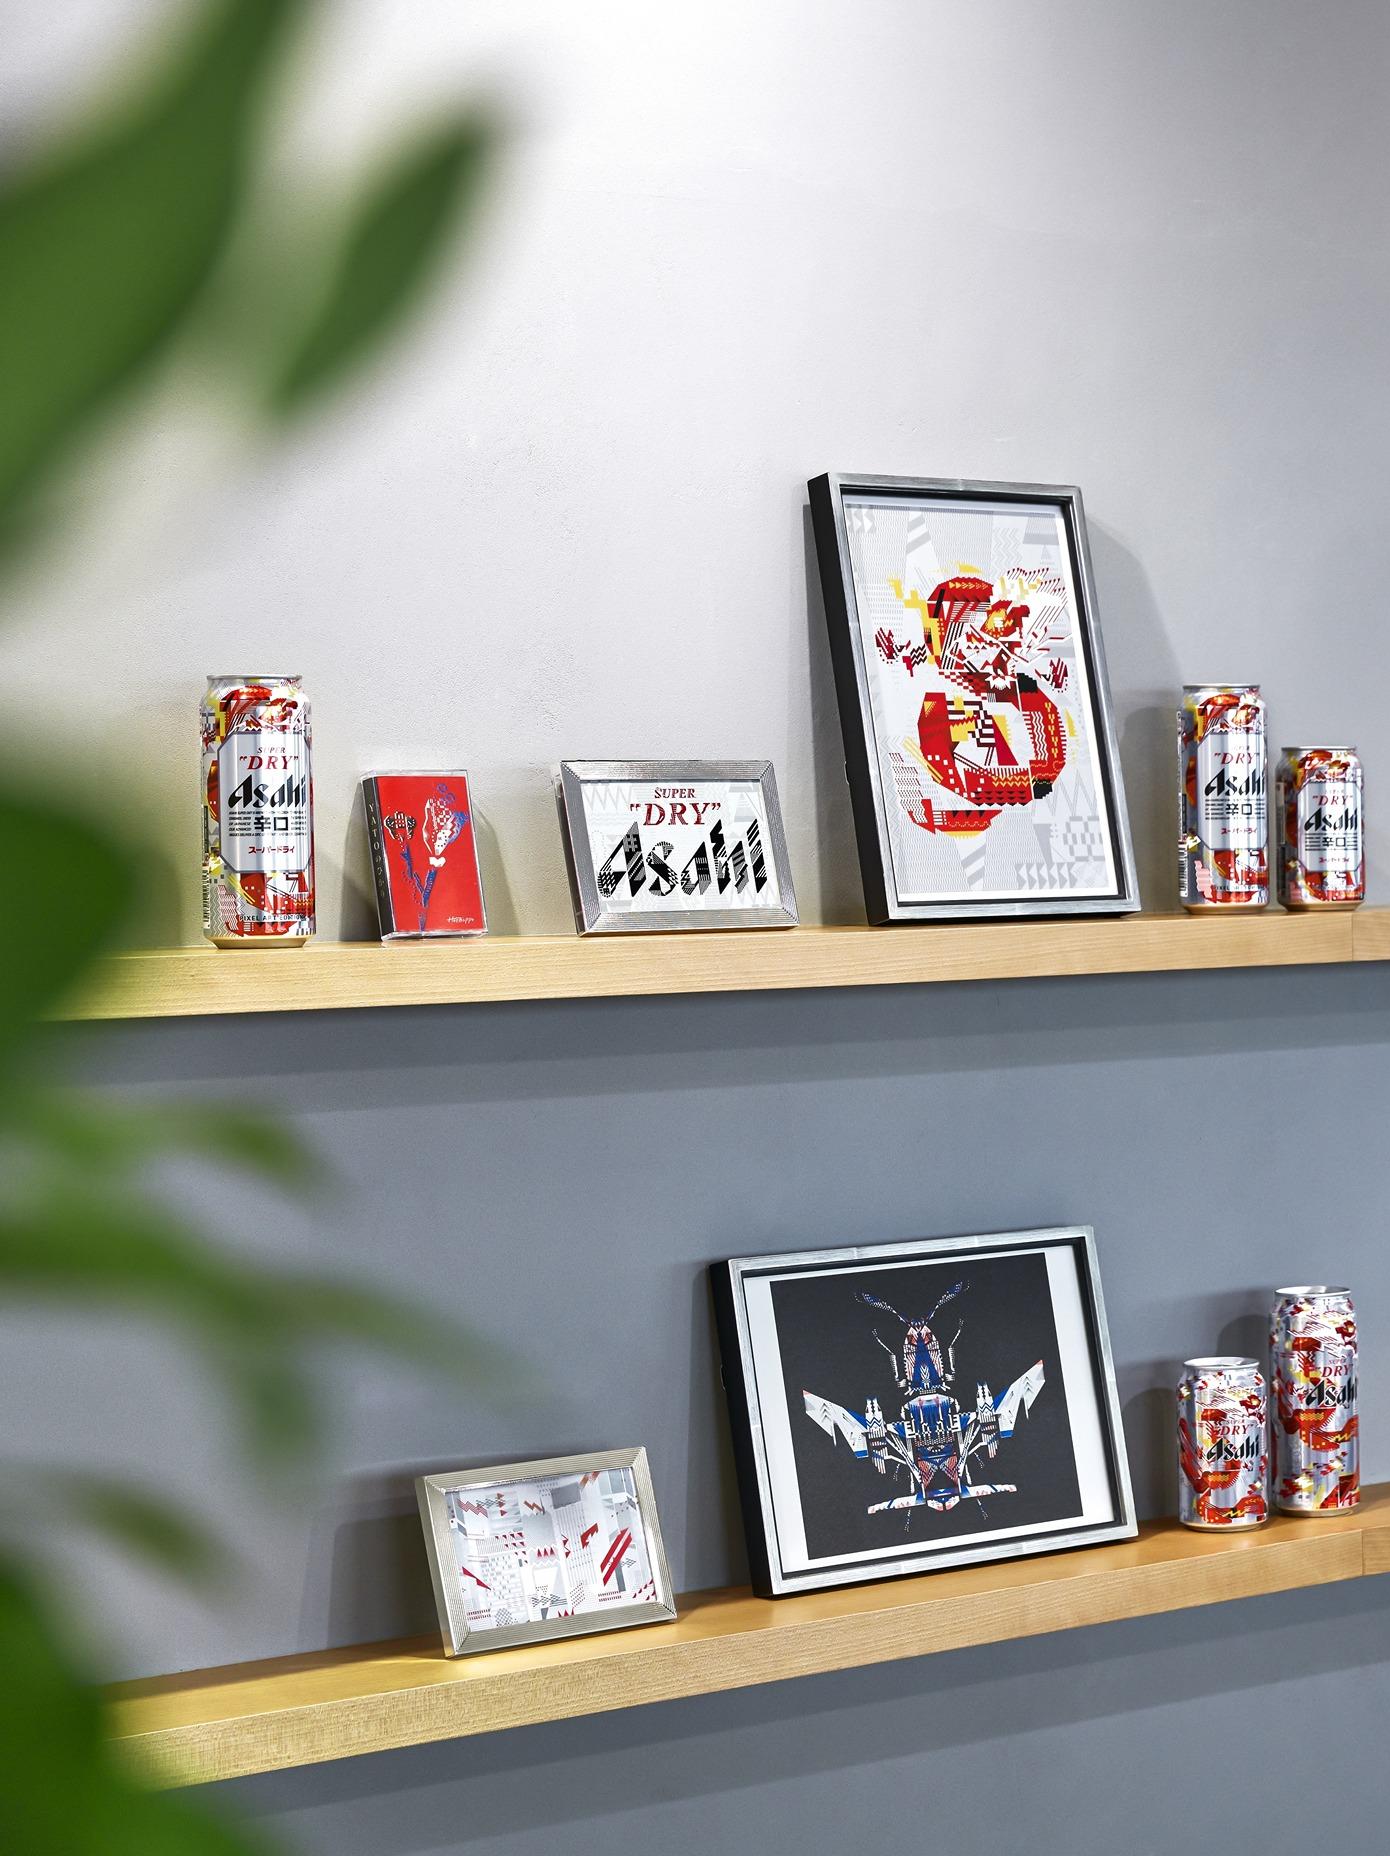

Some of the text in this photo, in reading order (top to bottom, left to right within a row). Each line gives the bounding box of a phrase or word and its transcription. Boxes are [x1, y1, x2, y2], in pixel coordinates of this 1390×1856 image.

[227, 774, 307, 809] Asahi
[654, 787, 696, 799] SUPER
[1204, 768, 1265, 797] Asahi
[1304, 807, 1358, 832] Asahi
[597, 818, 768, 899] Asahi
[1206, 1436, 1260, 1461] Asahi
